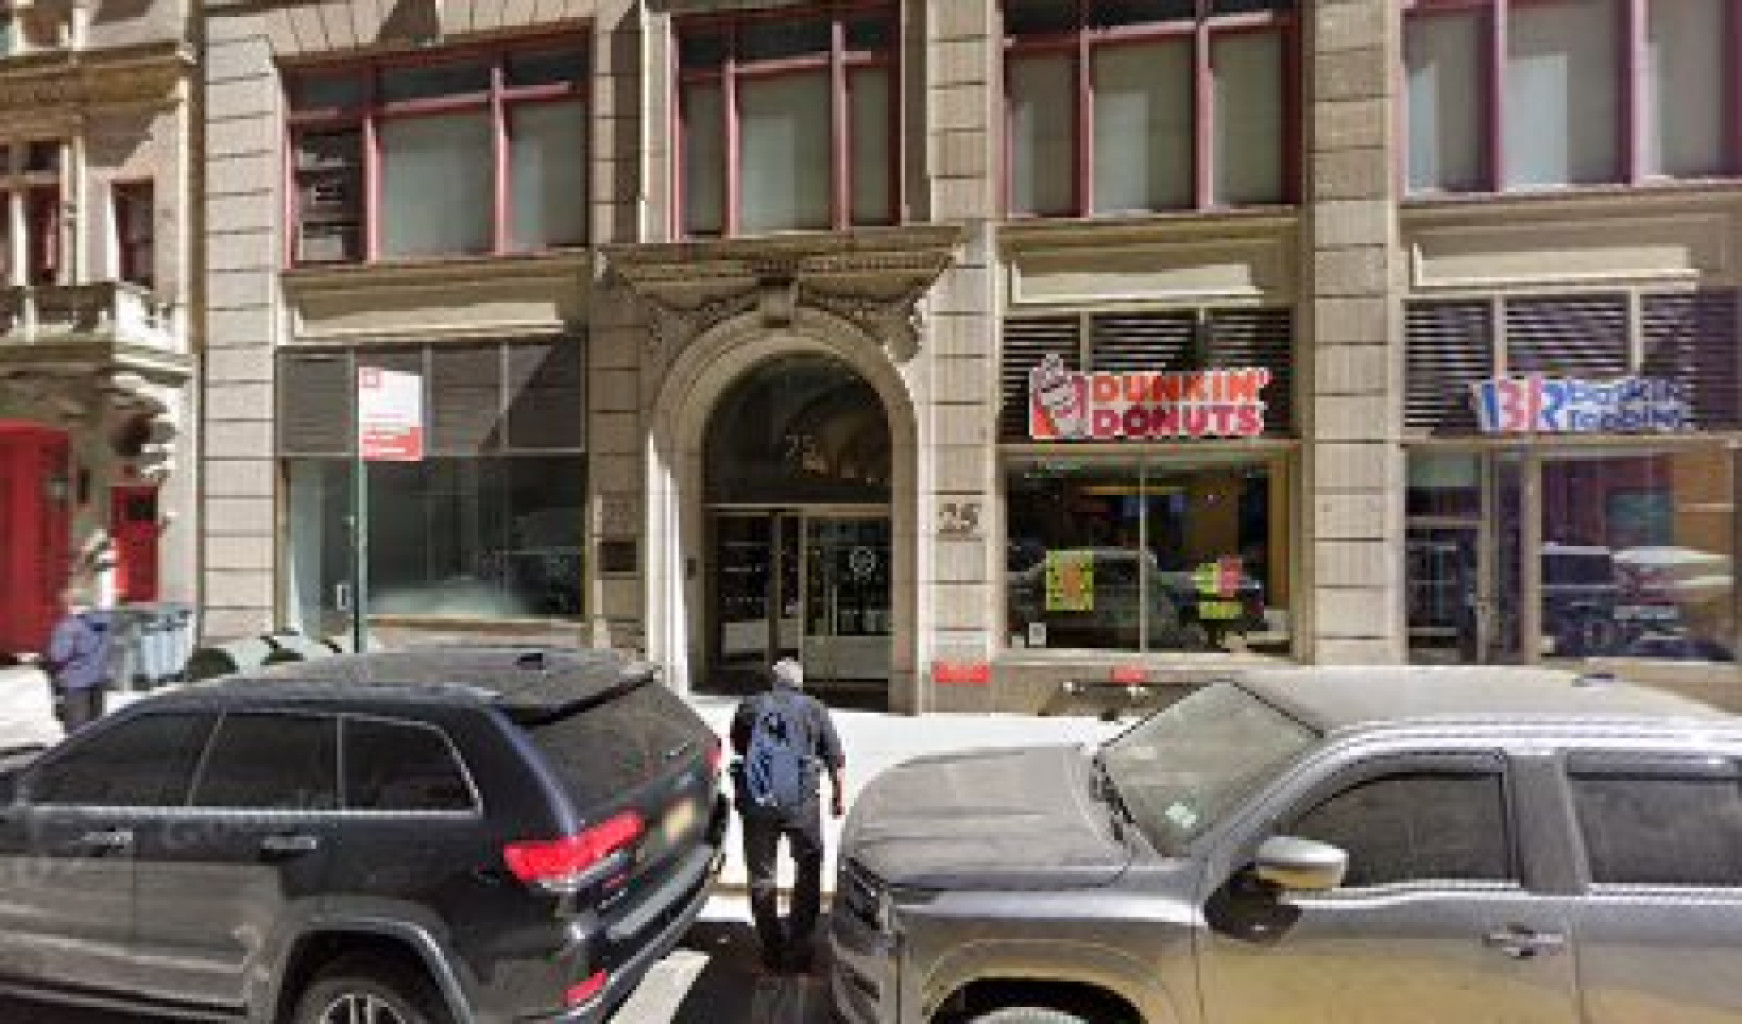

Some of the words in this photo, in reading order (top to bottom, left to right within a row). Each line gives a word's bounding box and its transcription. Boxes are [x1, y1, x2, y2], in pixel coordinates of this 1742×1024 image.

[1093, 368, 1272, 402] DUNKIN'
[1093, 404, 1264, 437] DONUTS
[937, 502, 983, 535] 25
